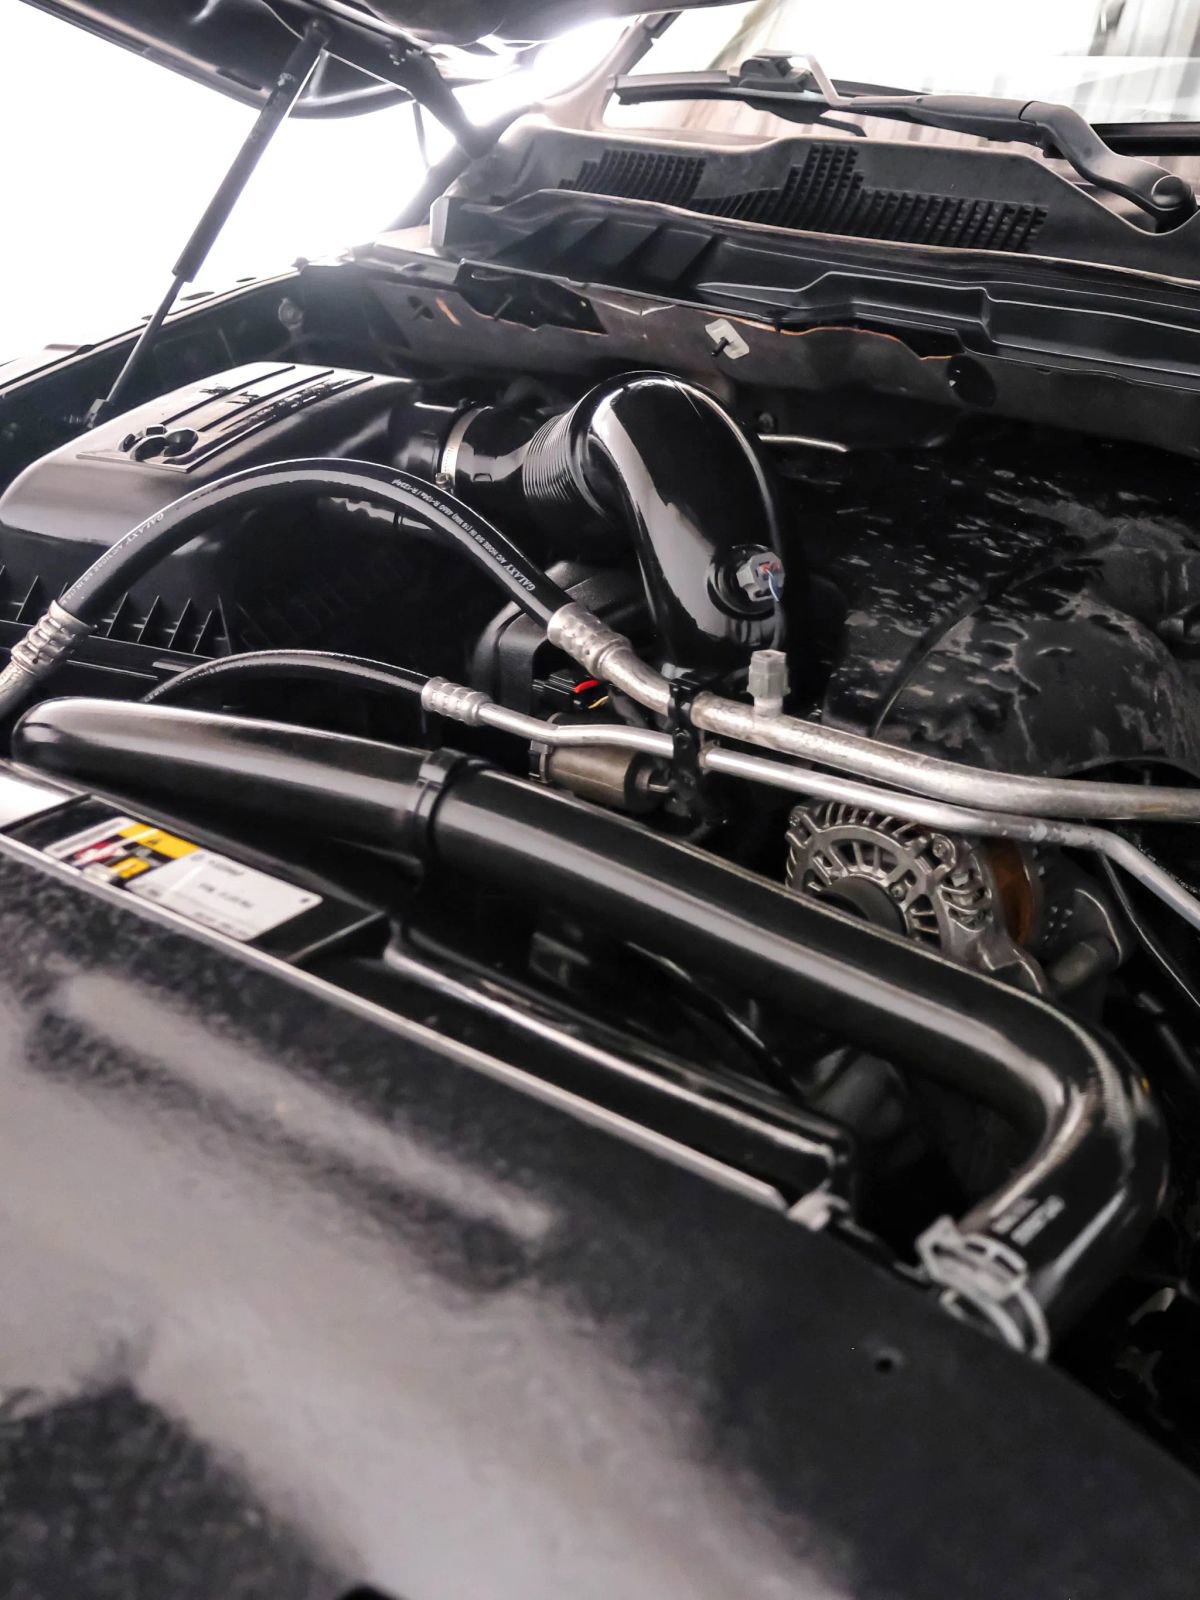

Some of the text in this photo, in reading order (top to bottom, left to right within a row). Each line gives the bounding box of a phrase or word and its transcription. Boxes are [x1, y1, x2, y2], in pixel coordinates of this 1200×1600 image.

[126, 512, 164, 544] GALAXY
[482, 540, 499, 556] HOSE
[504, 563, 536, 591] GALAXY
